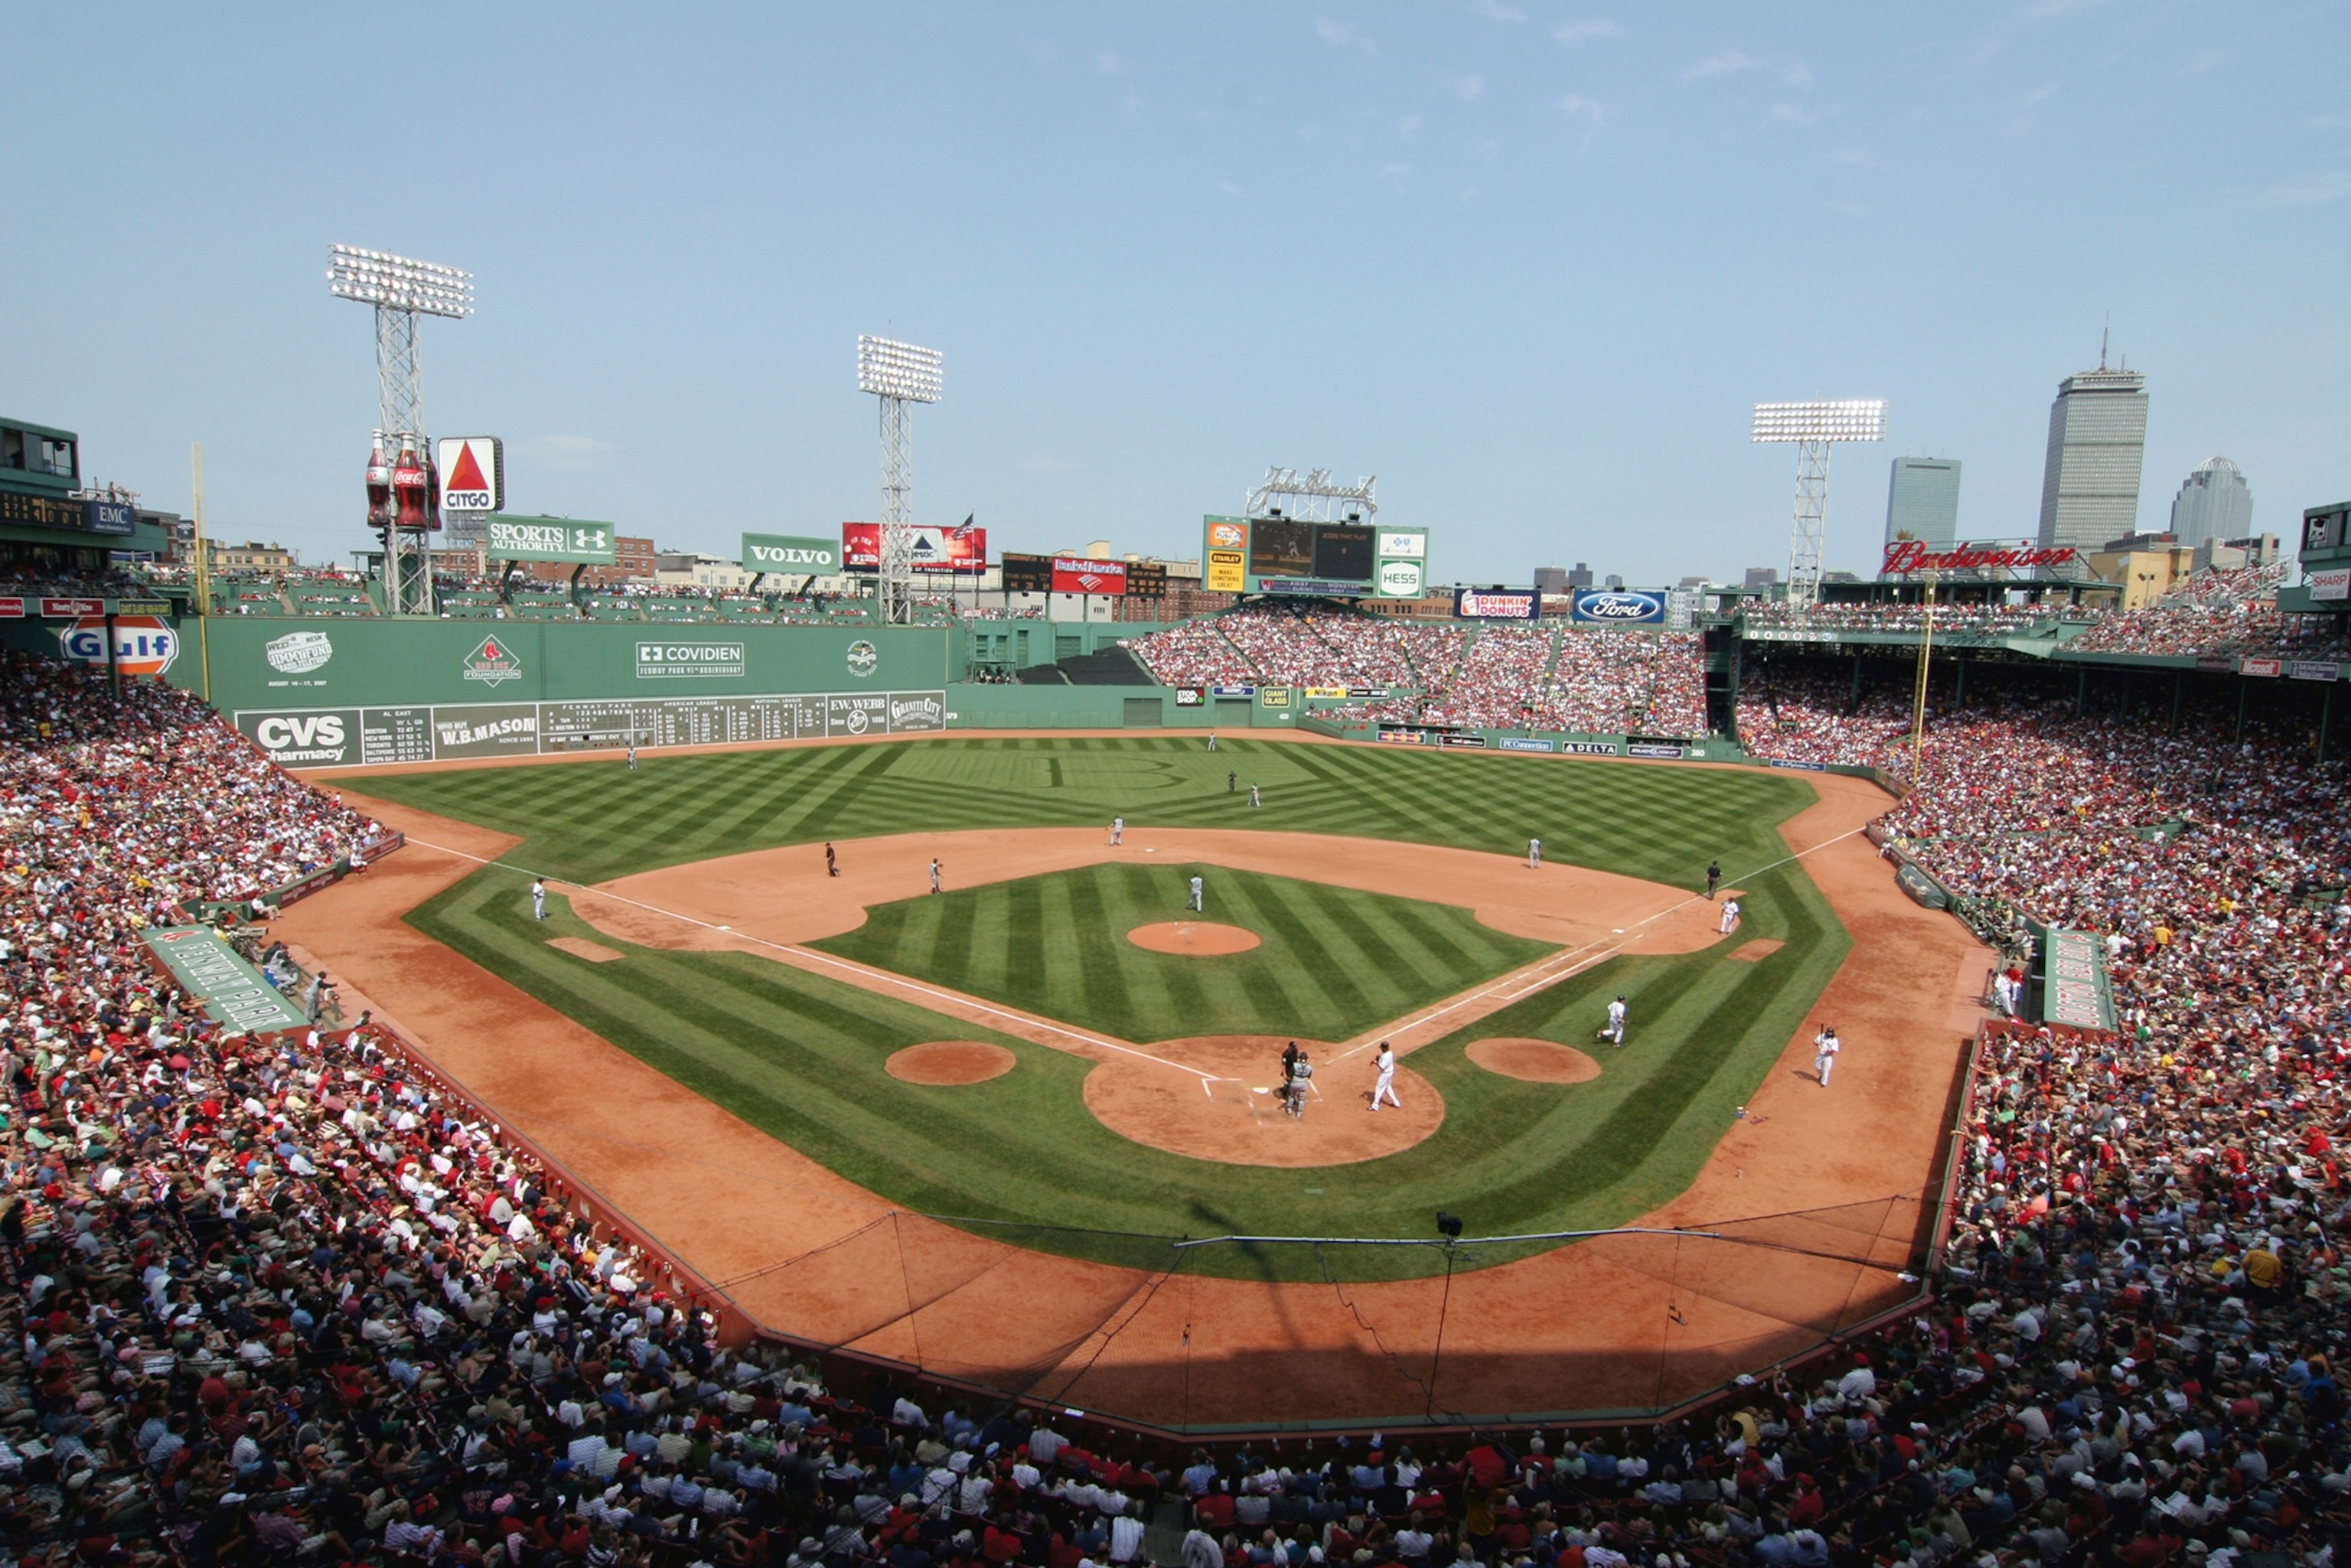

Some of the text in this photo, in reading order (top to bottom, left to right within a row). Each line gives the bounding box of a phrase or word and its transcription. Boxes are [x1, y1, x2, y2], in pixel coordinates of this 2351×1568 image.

[447, 493, 489, 507] CITGO
[490, 523, 564, 543] SPORTS
[750, 546, 832, 566] VOLVO
[1213, 554, 1240, 562] STANLEY
[1883, 540, 2078, 573] Budweiser
[1055, 559, 1079, 572] Bank
[1088, 562, 1123, 575] America
[1384, 573, 1417, 584] HESS
[2314, 575, 2346, 587] SHARP
[1480, 596, 1533, 606] DUNKIN'
[1593, 596, 1642, 617] Ford
[1479, 606, 1529, 616] DONUTS
[270, 643, 332, 666] JIMMY FUND
[667, 647, 740, 660] COVIDIEN
[699, 666, 742, 674] ANNIVERSARY
[2242, 660, 2274, 674] Microsoft
[853, 698, 885, 709] WEBB
[454, 721, 468, 729] BUT
[257, 716, 344, 748] CVS
[1513, 740, 1549, 750] Connection
[1577, 742, 1615, 754] DELTA
[1691, 748, 1705, 758] 380
[170, 941, 292, 1031] FENWAY PARK
